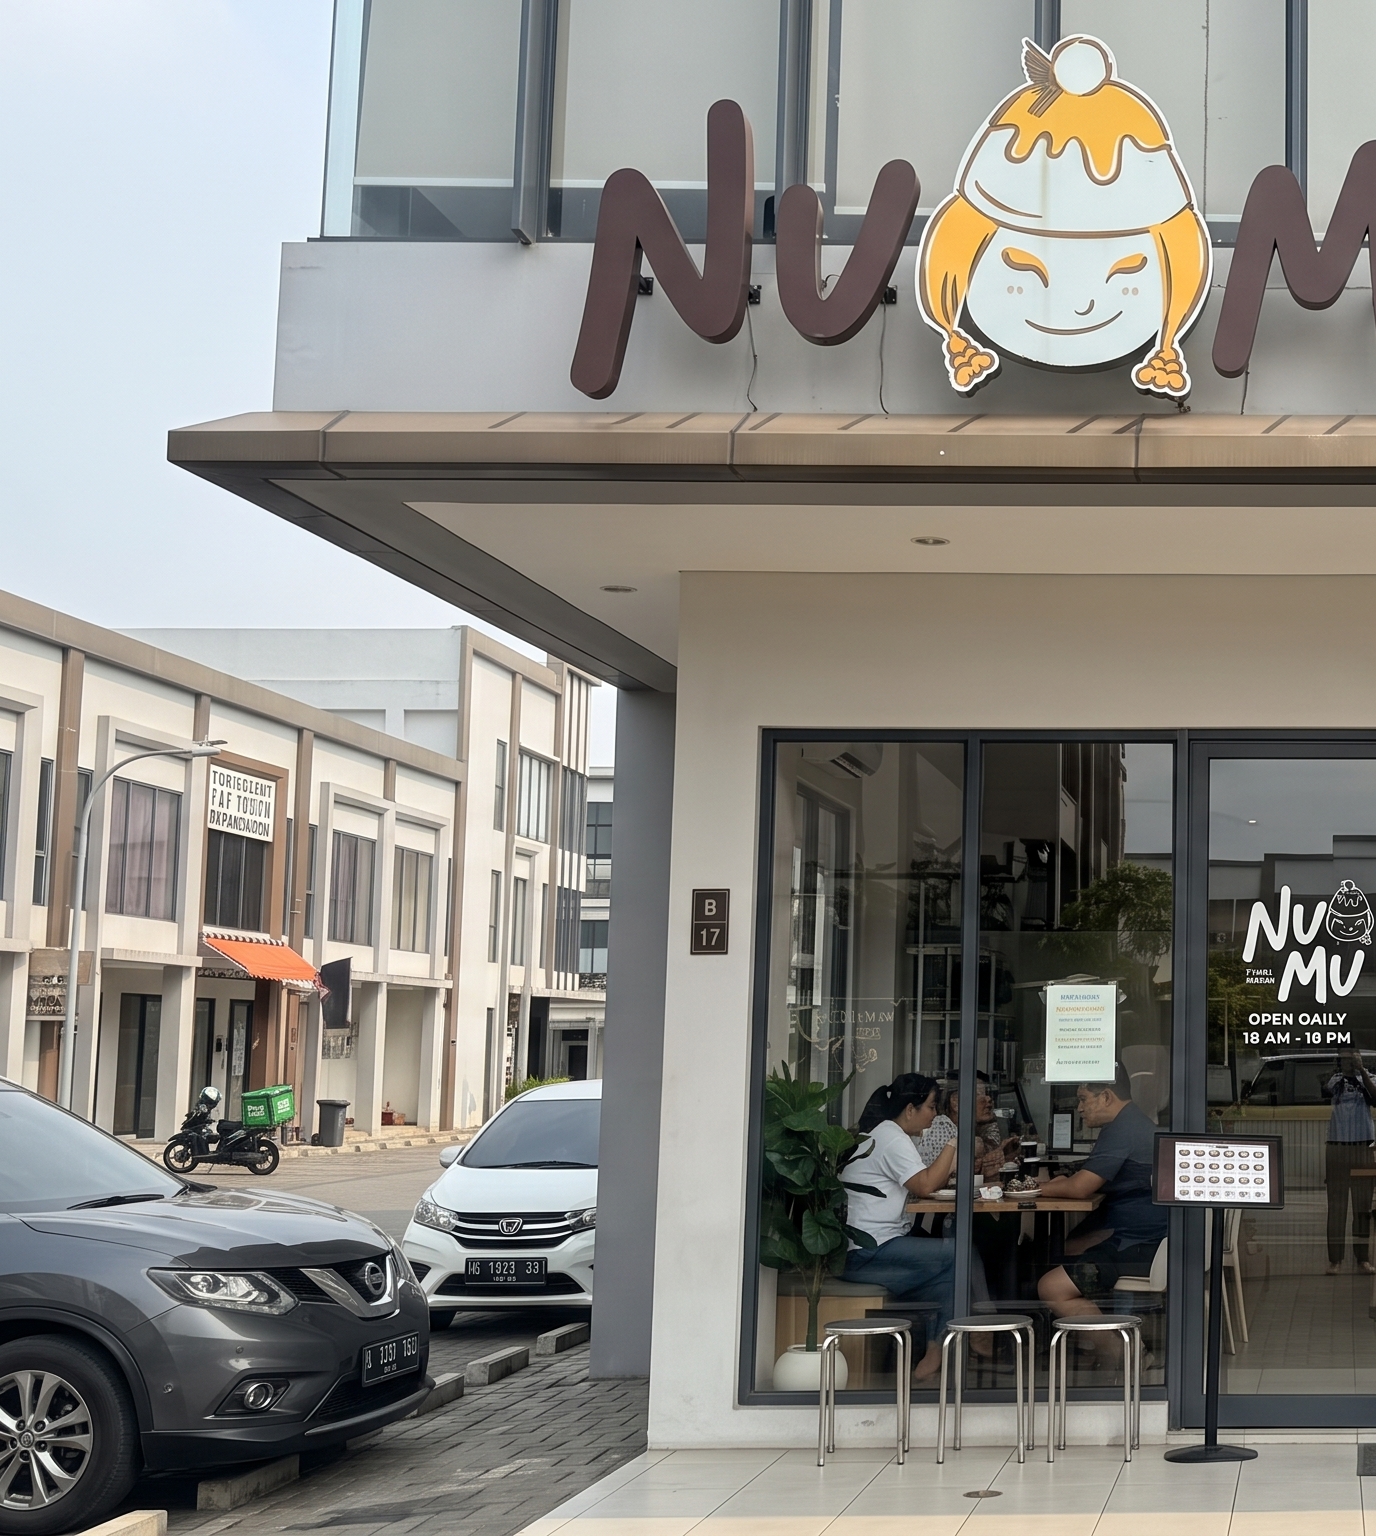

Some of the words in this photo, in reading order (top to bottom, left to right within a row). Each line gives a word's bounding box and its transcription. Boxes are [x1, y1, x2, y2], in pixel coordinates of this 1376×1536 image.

[704, 898, 717, 916] B
[700, 927, 721, 946] 17
[1248, 1012, 1294, 1026] OPEN
[1242, 1031, 1261, 1044] 18
[1264, 1031, 1291, 1044] AM
[1326, 1031, 1351, 1044] PM
[525, 1261, 540, 1275] 33
